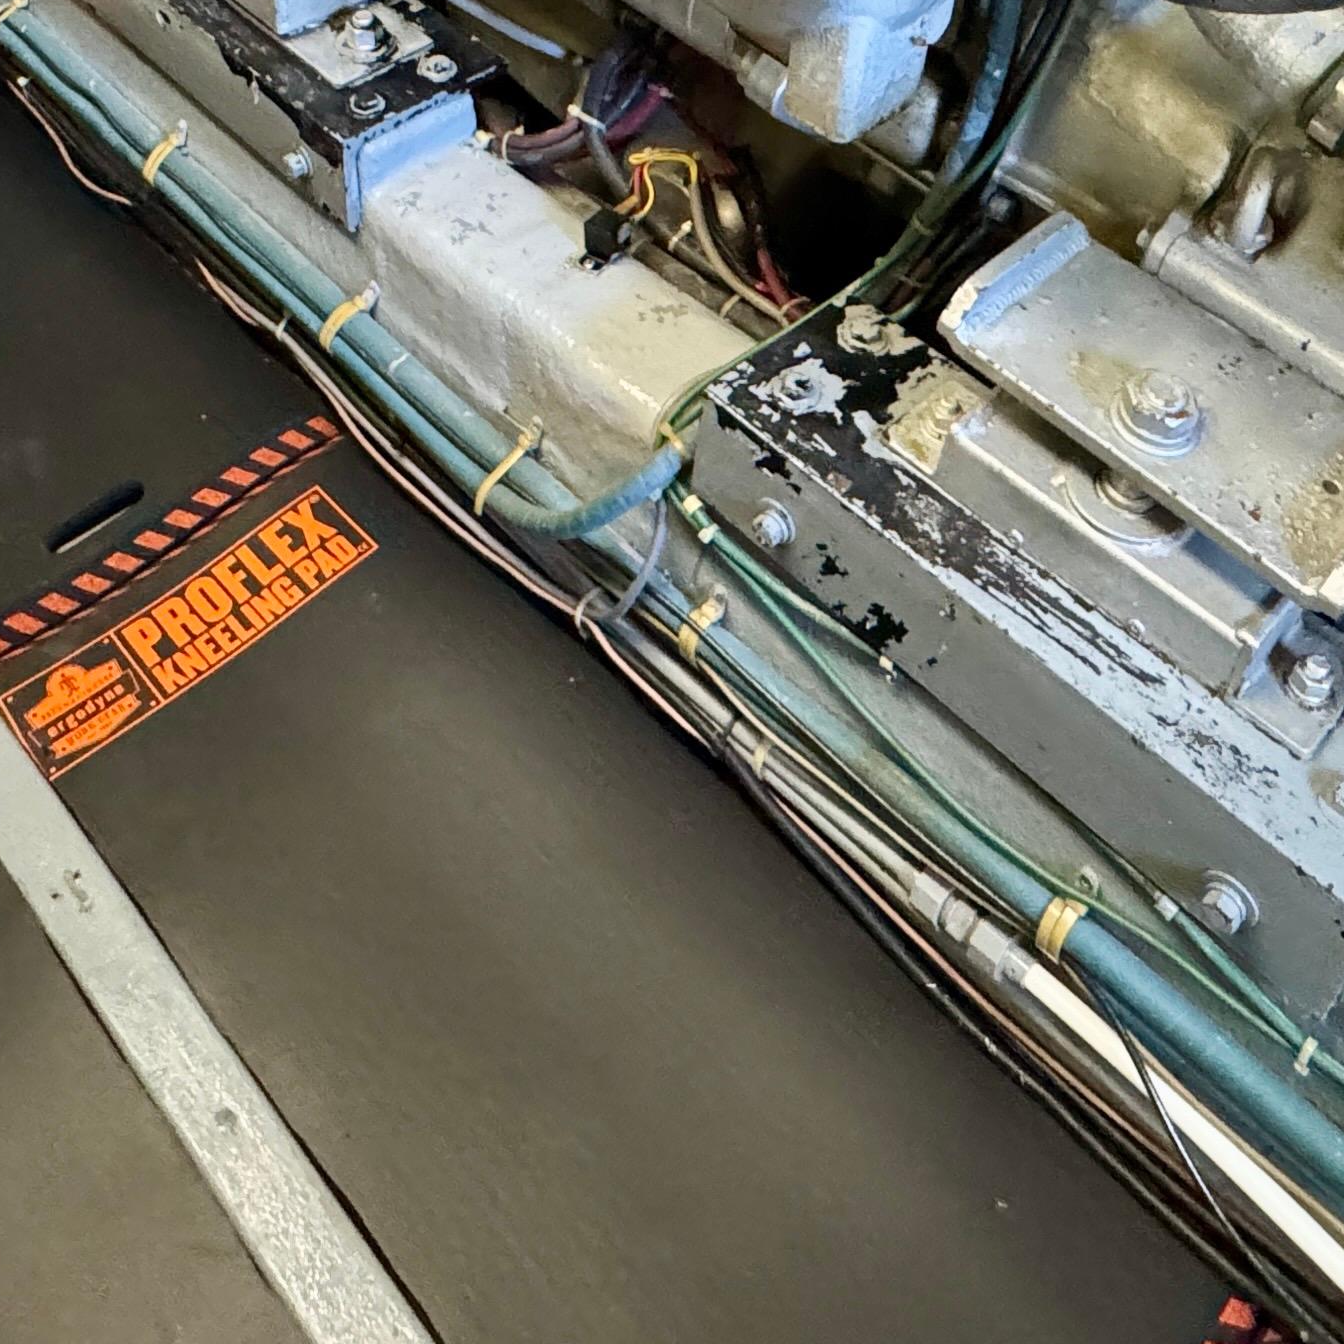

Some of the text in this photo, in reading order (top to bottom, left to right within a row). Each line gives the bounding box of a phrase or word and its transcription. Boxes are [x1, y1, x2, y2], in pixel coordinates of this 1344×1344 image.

[120, 499, 340, 669] PROFLEX
[150, 575, 305, 695] KNEELING
[293, 534, 360, 591] PAD
